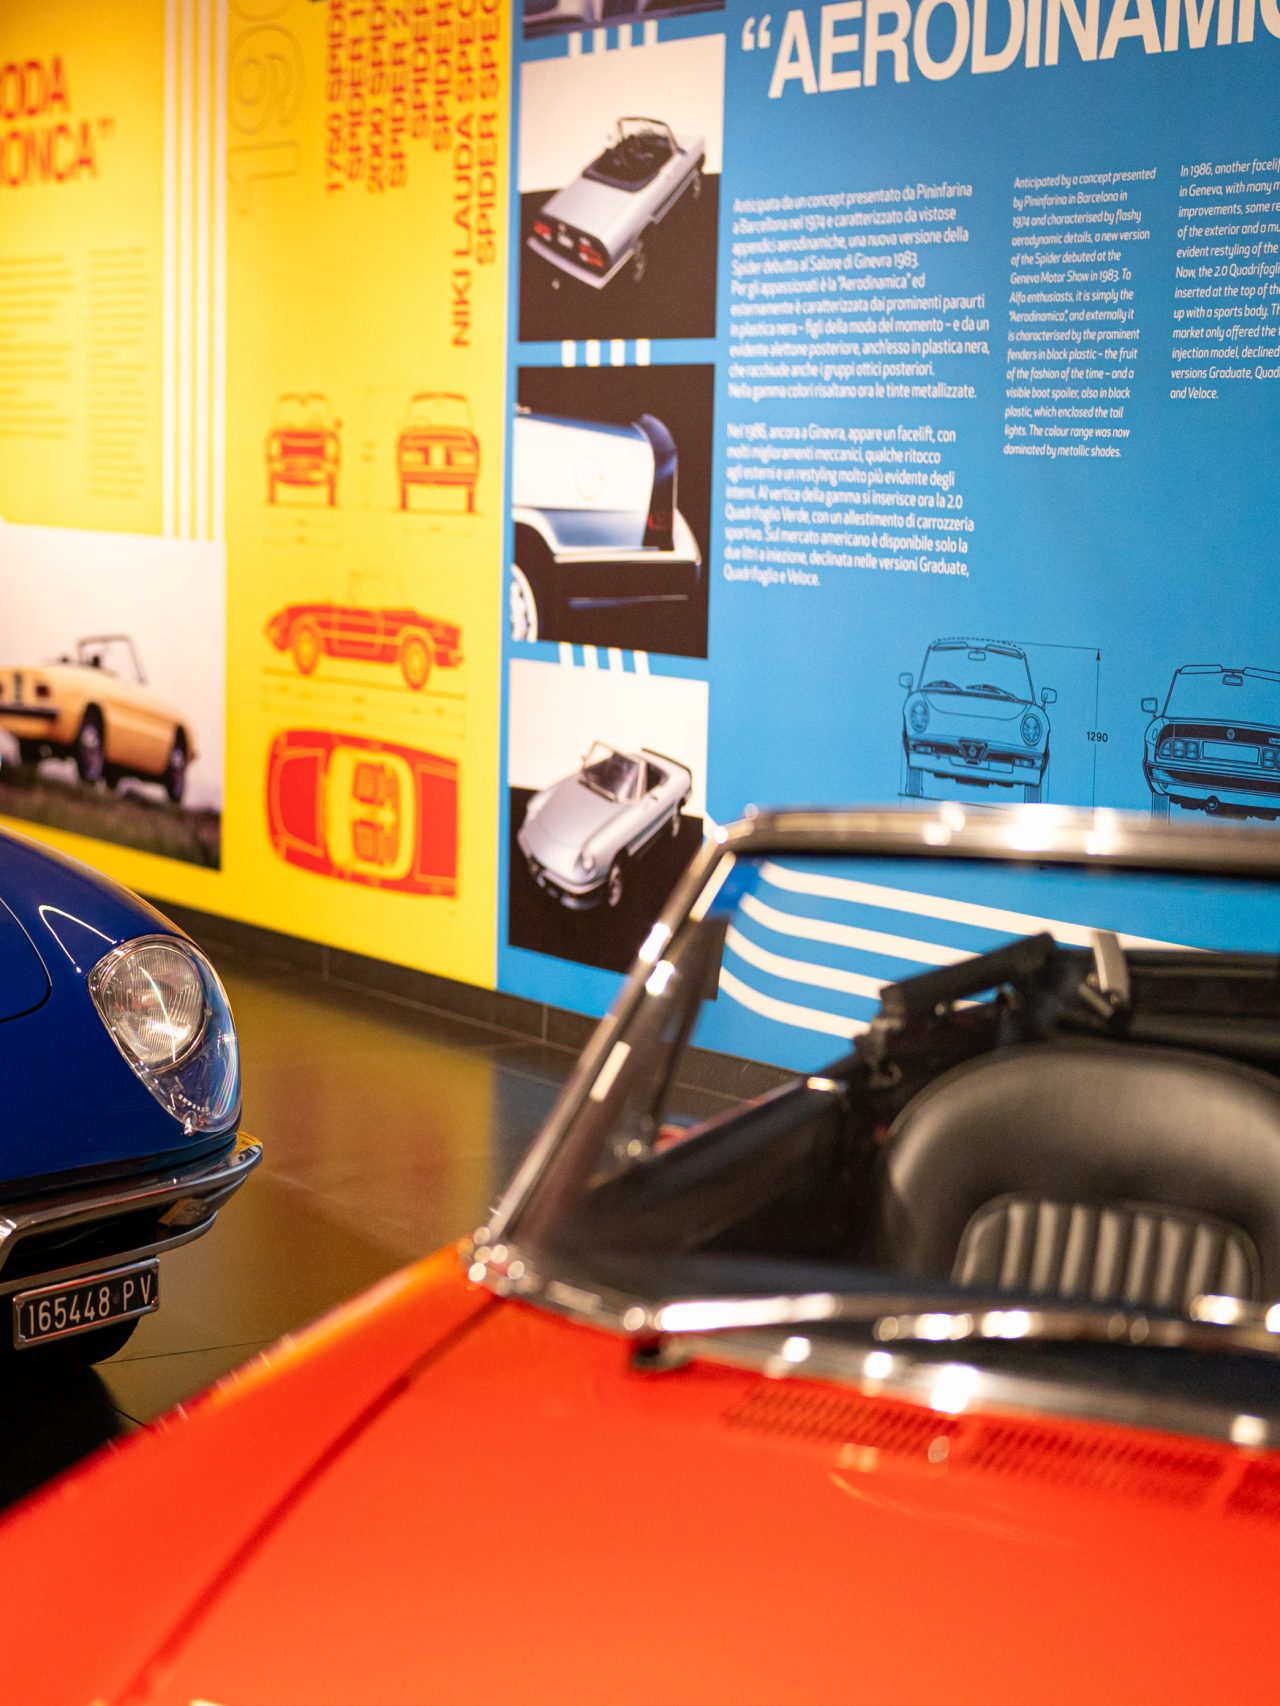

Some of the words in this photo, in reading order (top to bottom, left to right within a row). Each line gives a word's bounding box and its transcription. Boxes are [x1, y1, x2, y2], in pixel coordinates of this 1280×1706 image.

[326, 0, 348, 103] SPID
[369, 0, 390, 96] SPID
[1181, 165, 1188, 176] In
[1190, 162, 1212, 177] 1986,
[1215, 161, 1250, 174] another
[452, 113, 475, 257] LAUDA
[475, 111, 498, 266] SPIDER
[1179, 186, 1187, 197] in
[1189, 184, 1223, 196] Geneva,
[1226, 181, 1244, 193] with
[1246, 182, 1272, 194] many
[1178, 204, 1243, 220] improvements,
[1245, 202, 1270, 213] some
[1178, 225, 1188, 240] of
[1189, 226, 1203, 237] the
[1205, 224, 1241, 236] exterior
[1242, 221, 1259, 234] and
[1176, 245, 1209, 258] evident
[1211, 244, 1250, 259] restyling
[1252, 241, 1263, 257] of
[1264, 242, 1278, 253] the
[1176, 266, 1196, 278] Now,
[1199, 265, 1212, 277] the
[1214, 266, 1228, 276] 2.0
[1175, 285, 1212, 298] inserted
[1213, 286, 1222, 297] at
[1224, 285, 1238, 297] the
[1241, 285, 1255, 299] top
[1257, 283, 1269, 299] of
[451, 268, 472, 349] NIKI
[1174, 309, 1184, 321] up
[1187, 306, 1205, 318] with
[1214, 306, 1242, 320] sports
[1244, 305, 1268, 319] body.
[1173, 326, 1204, 338] market
[1206, 326, 1225, 341] only
[1226, 325, 1260, 340] offered
[1262, 325, 1276, 337] the
[1172, 347, 1209, 362] injection
[1211, 346, 1239, 359] model,
[1171, 368, 1207, 378] versions
[1209, 366, 1253, 379] Graduate,
[1170, 387, 1186, 399] and
[1188, 387, 1218, 399] Veloce.
[1086, 731, 1108, 743] 1290
[28, 1286, 110, 1335] 165448
